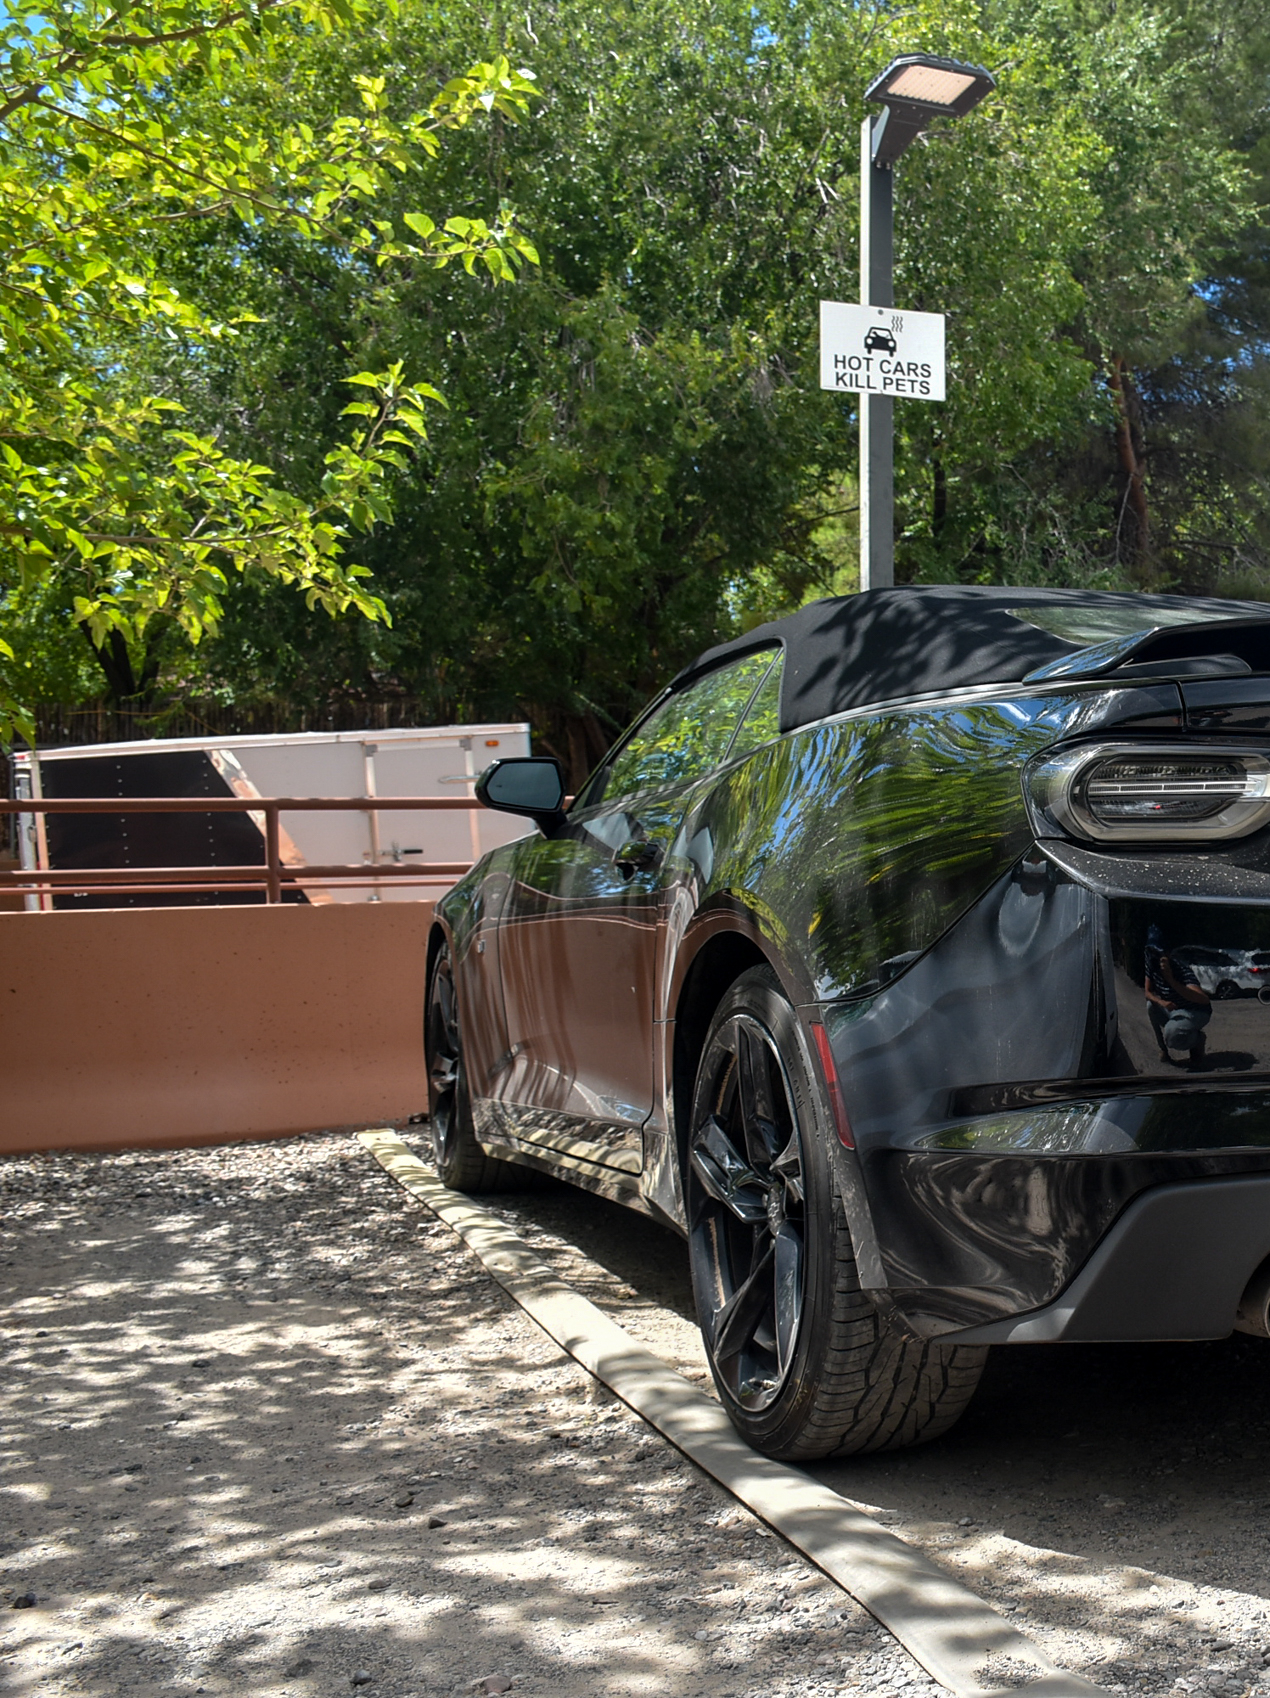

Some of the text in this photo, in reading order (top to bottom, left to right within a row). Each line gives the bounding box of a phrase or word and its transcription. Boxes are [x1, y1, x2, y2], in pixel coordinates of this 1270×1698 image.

[834, 354, 932, 378] HOT CARS
[835, 371, 931, 395] KILL PETS
